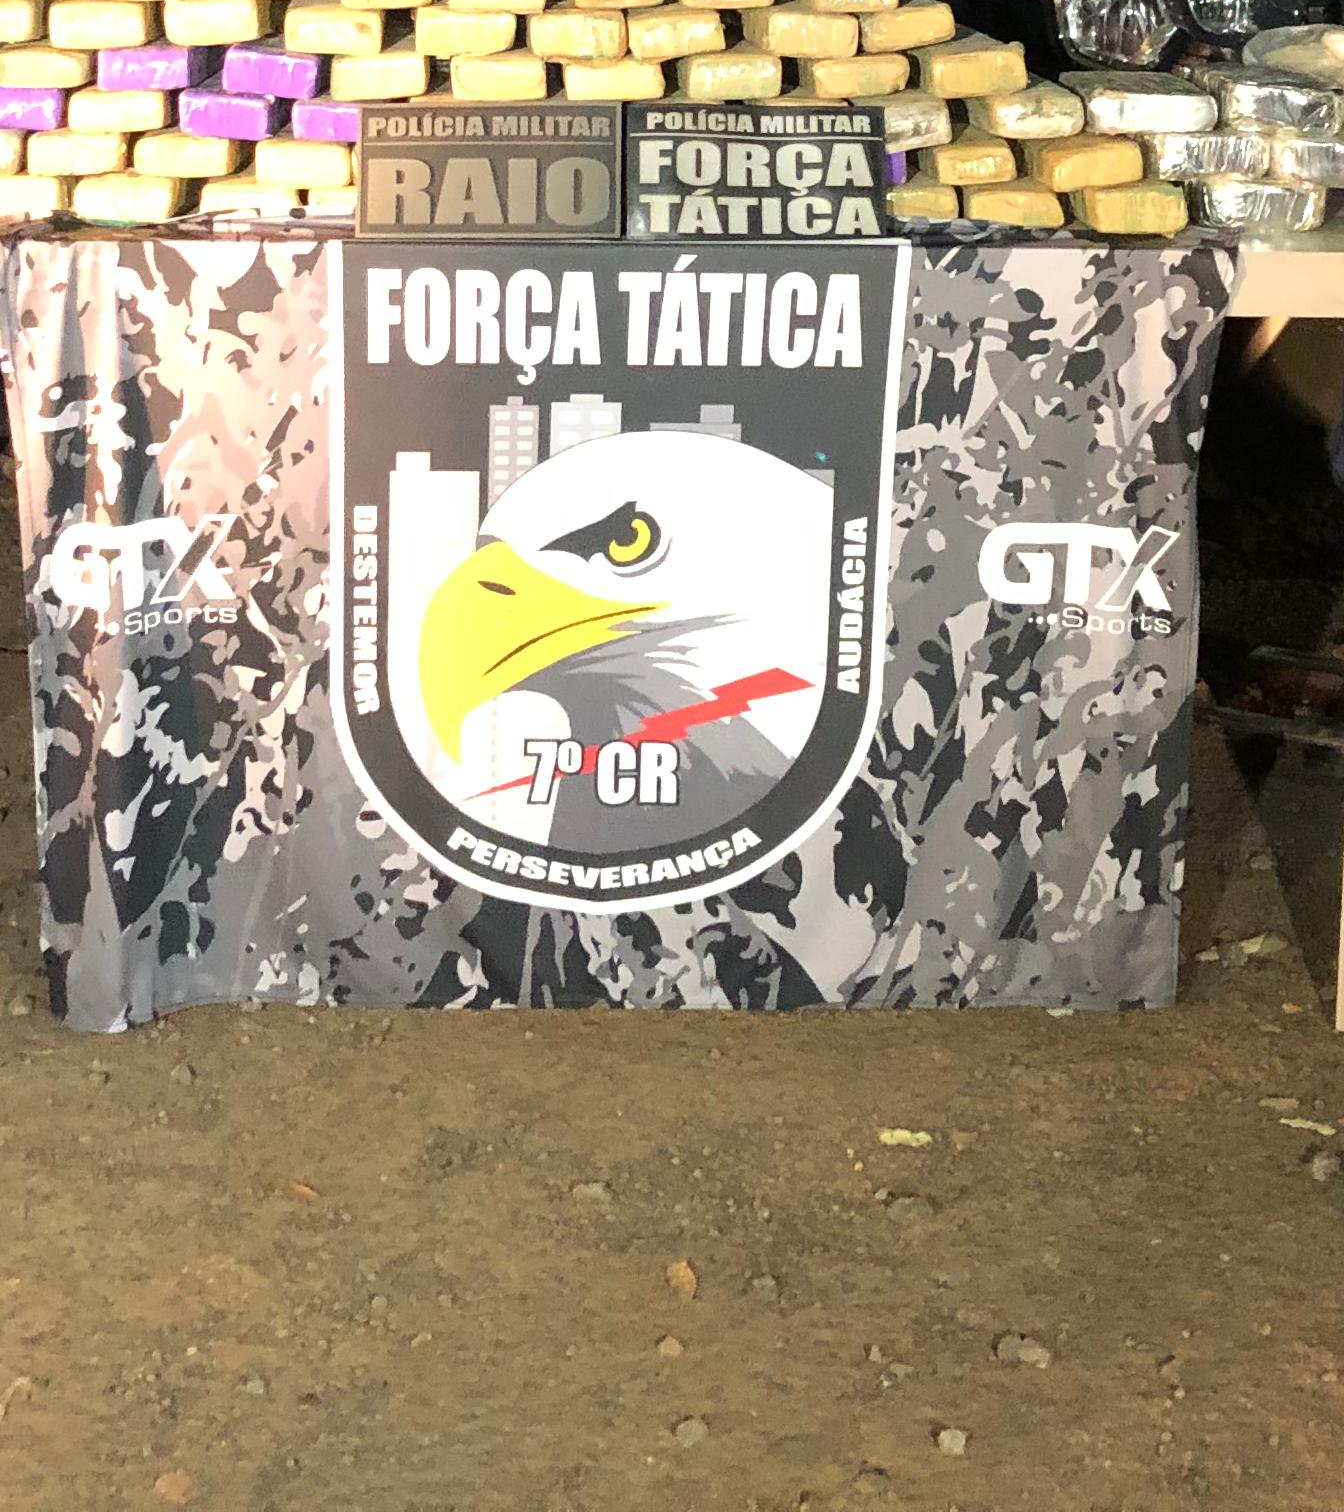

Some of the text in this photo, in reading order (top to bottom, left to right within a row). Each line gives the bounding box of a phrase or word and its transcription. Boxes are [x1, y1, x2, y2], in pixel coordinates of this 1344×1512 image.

[368, 112, 610, 137] POLÍCIA MILITAR
[646, 109, 871, 134] POLÍCIA MILITAR
[367, 157, 610, 226] RAIO
[639, 140, 874, 196] FORÇA
[639, 189, 881, 236] TÁTICA
[367, 254, 862, 385] FORÇA TÁTICA
[50, 514, 240, 610] GTX
[978, 522, 1180, 612] GTX
[353, 505, 380, 715] DESTEMOR
[837, 516, 868, 694] AUDÁCIA
[596, 740, 680, 806] CR
[446, 826, 762, 888] PERSEVERANÇA
